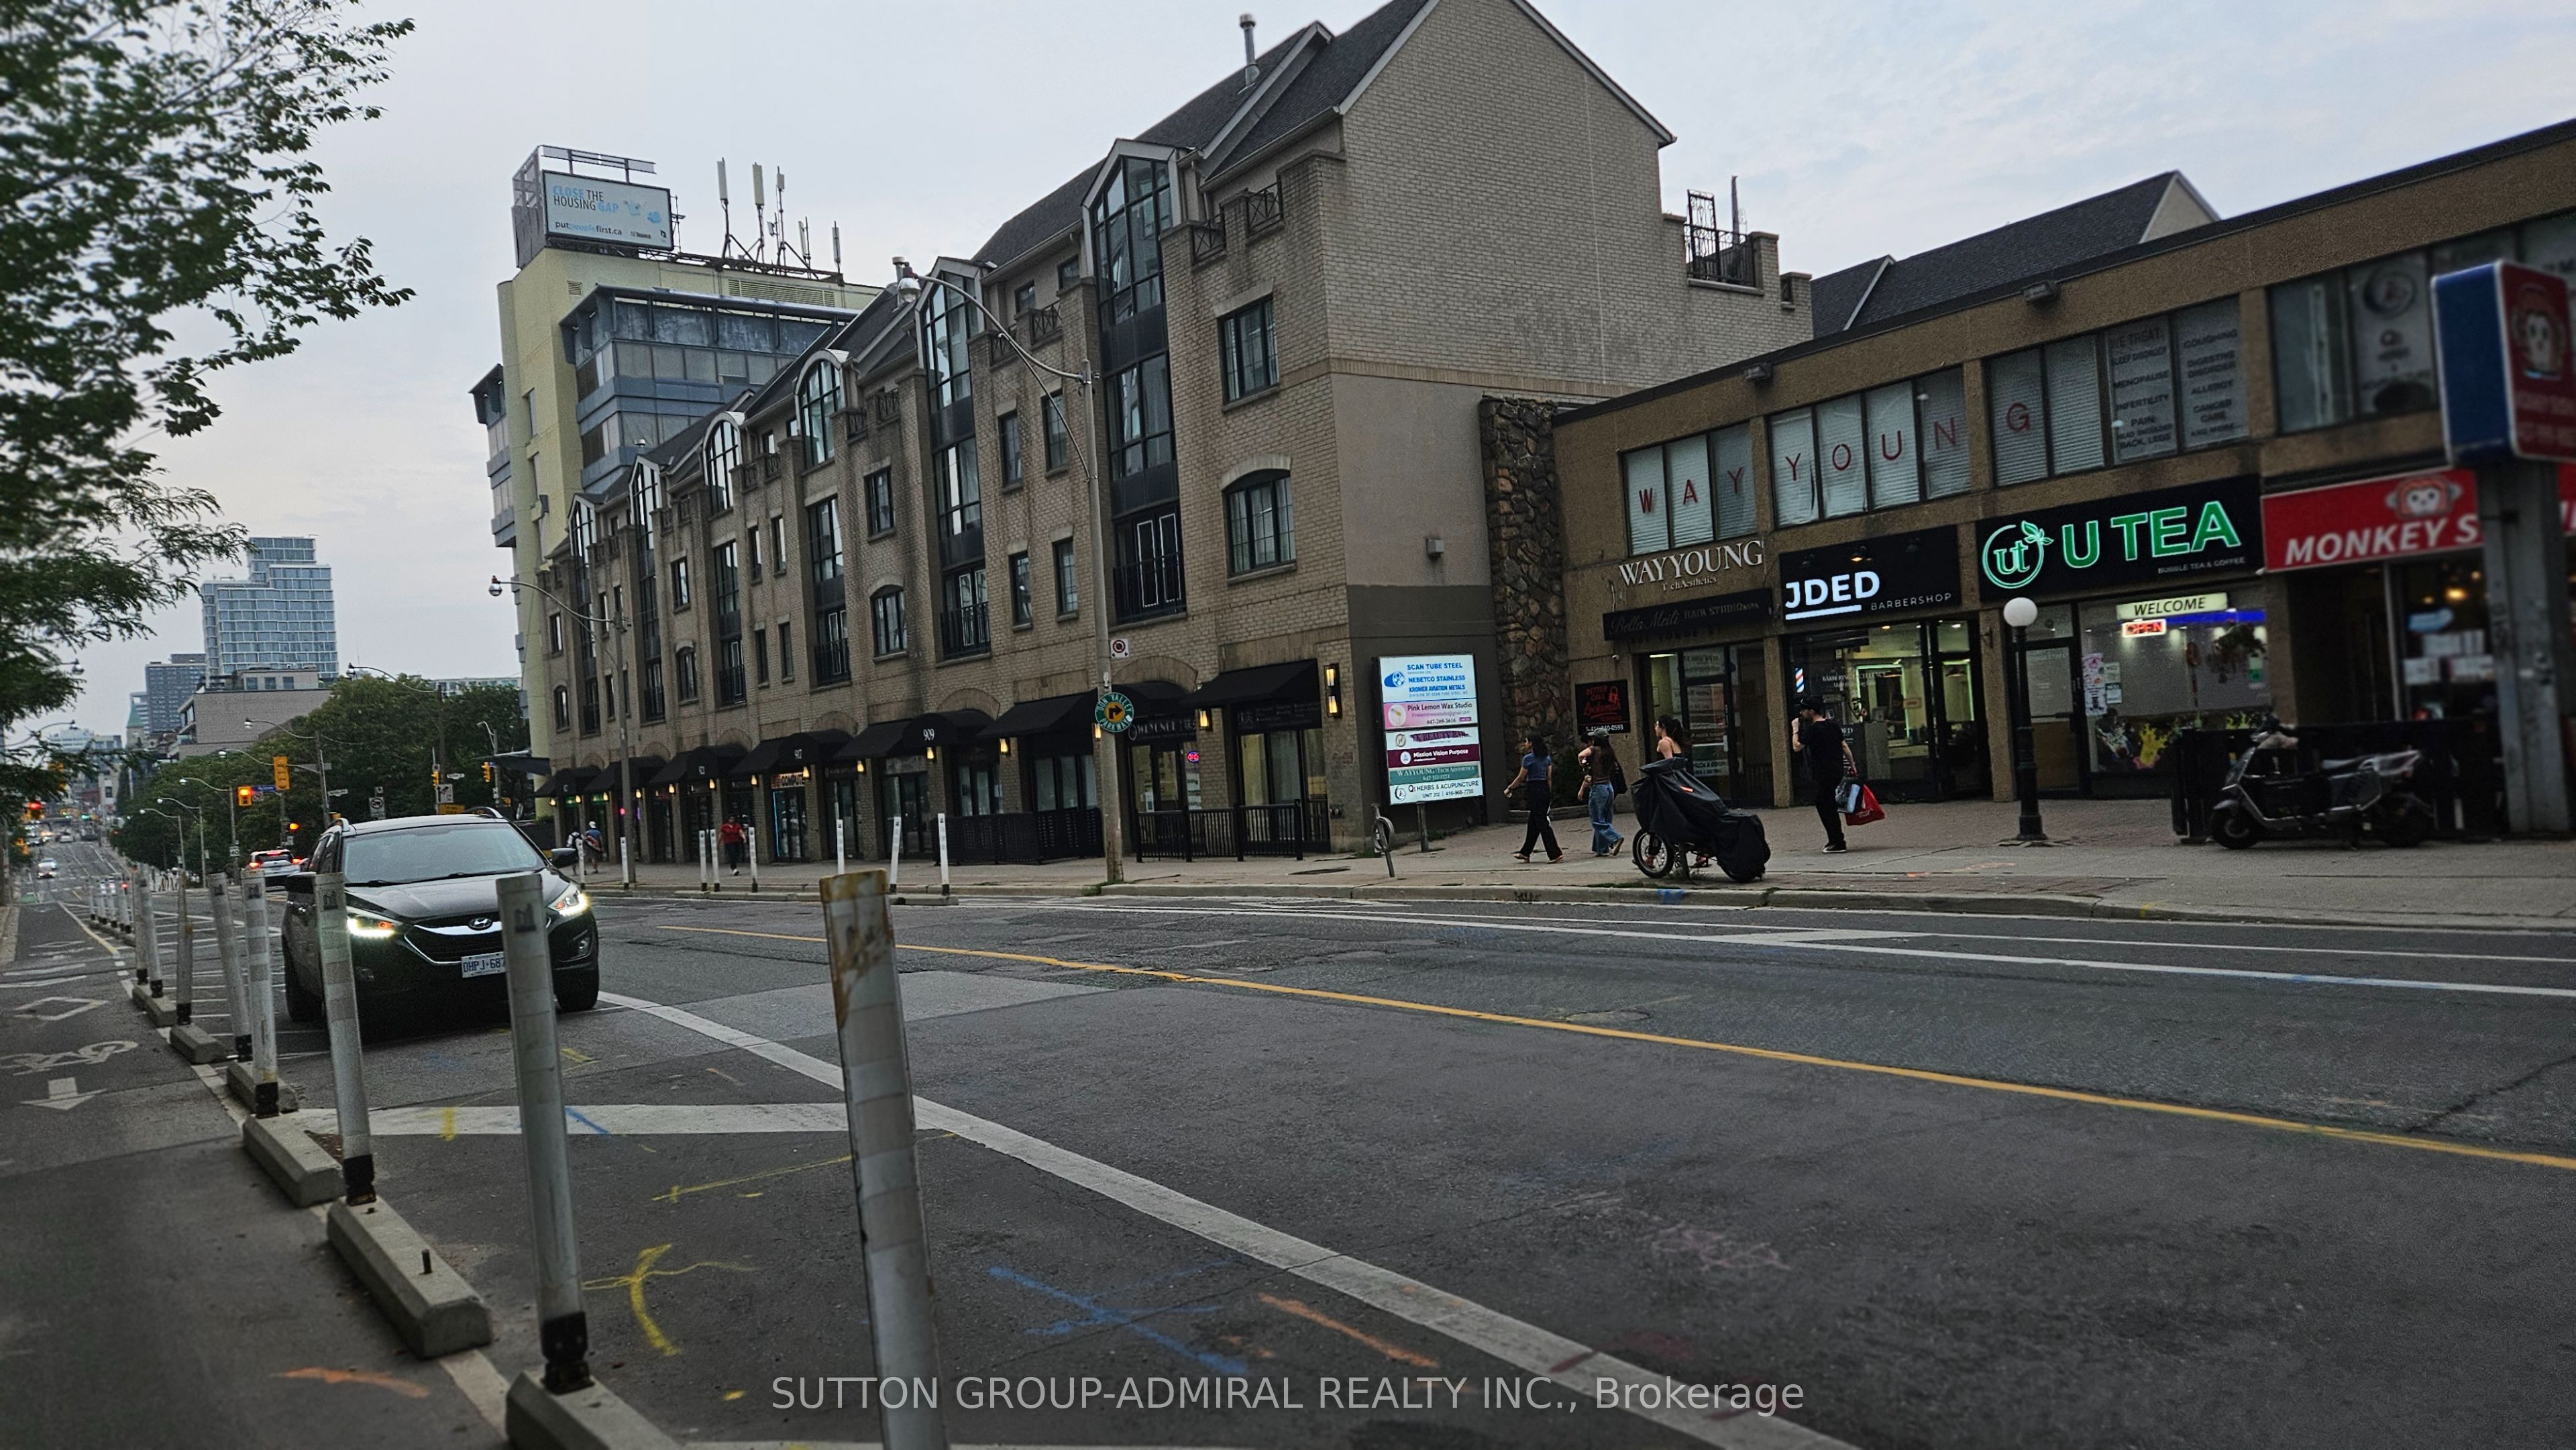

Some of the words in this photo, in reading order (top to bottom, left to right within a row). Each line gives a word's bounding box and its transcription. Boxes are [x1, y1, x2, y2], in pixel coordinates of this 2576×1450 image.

[553, 186, 584, 197] CLOSE
[586, 189, 604, 201] THE
[553, 195, 596, 210] HOUSING
[597, 202, 619, 213] GAP
[2061, 520, 2100, 568] U
[2110, 501, 2241, 560] TEA
[2285, 518, 2448, 565] MONKEY
[2190, 561, 2206, 570] TEA
[2214, 556, 2246, 567] COFFEE
[1785, 570, 1880, 609] JDED
[1870, 592, 1953, 612] BARBERSHOP
[2134, 597, 2206, 617] WELCOME
[2125, 621, 2163, 635] OPEN
[1096, 698, 1108, 712] DON
[1110, 693, 1132, 713] VALLEY
[1099, 717, 1132, 731] PARKWAY
[922, 728, 935, 741] 909
[1440, 780, 1479, 789] ACUPUNCTURE
